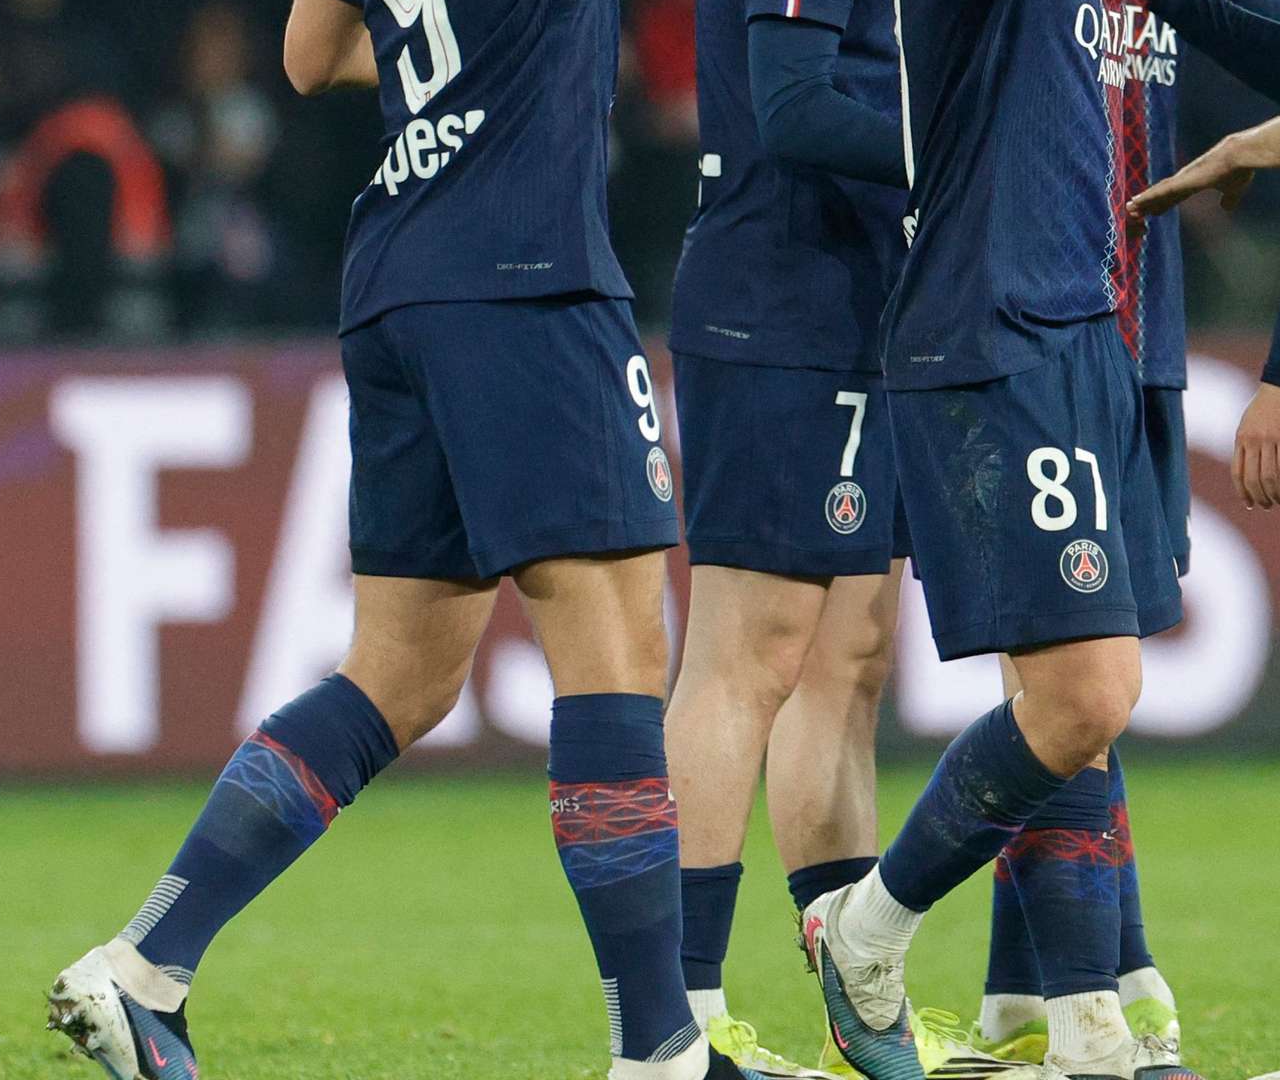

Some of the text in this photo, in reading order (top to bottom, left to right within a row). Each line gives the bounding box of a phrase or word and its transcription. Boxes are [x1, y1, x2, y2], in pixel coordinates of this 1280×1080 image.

[626, 355, 660, 442] 9
[835, 391, 868, 477] 7
[1026, 446, 1107, 532] 87
[1067, 542, 1100, 557] PARIS
